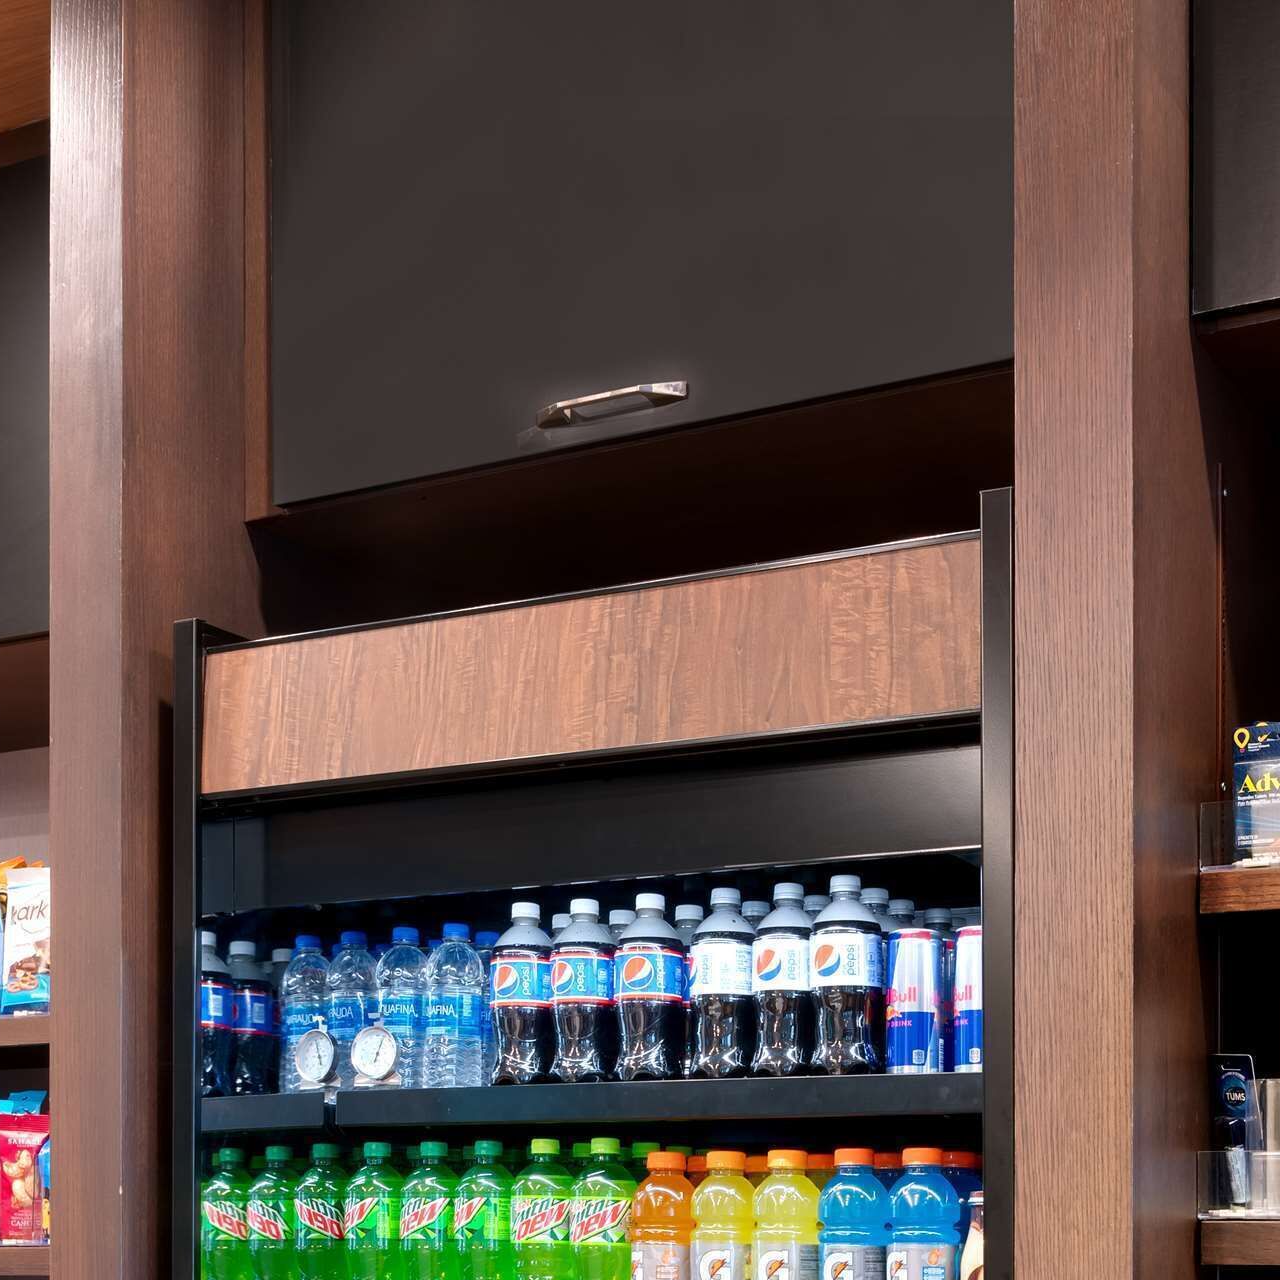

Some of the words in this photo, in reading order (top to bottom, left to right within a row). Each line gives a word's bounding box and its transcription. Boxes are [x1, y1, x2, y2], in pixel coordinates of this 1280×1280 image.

[522, 966, 531, 996] pepsi
[577, 962, 587, 992] pepsi
[1226, 1091, 1247, 1102] TUMS
